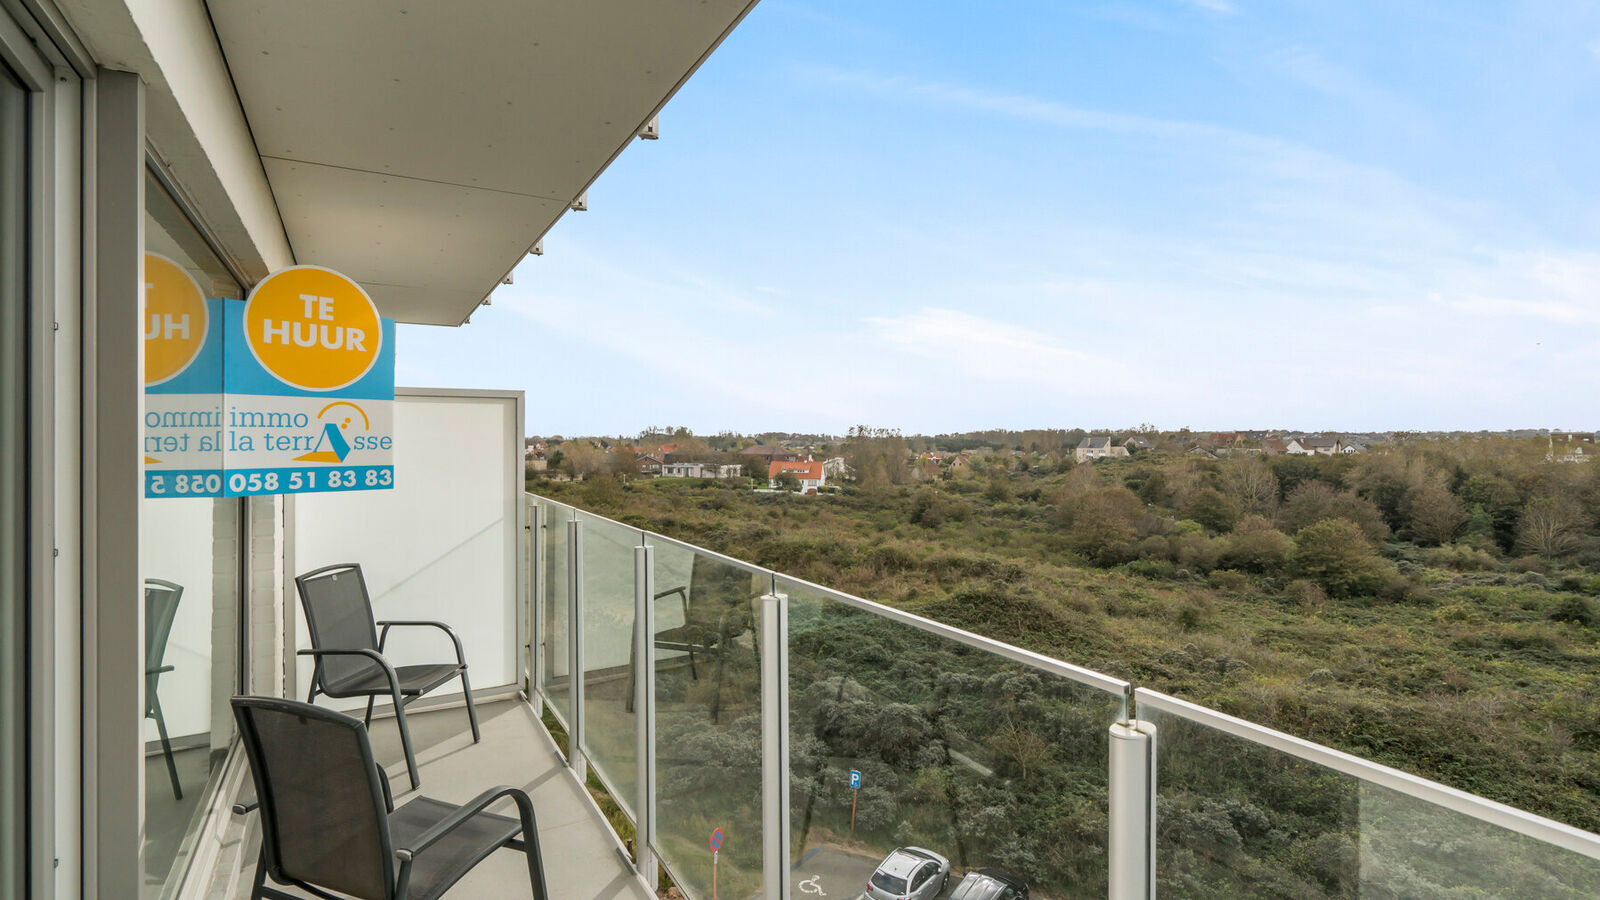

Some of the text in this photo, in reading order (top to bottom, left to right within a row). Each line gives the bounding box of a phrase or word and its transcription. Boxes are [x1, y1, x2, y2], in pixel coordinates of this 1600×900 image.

[299, 294, 334, 321] TE
[263, 318, 367, 352] HUUR
[229, 407, 309, 428] immo
[229, 431, 255, 451] la
[229, 469, 393, 493] 058 51 83 83
[851, 773, 859, 784] P
